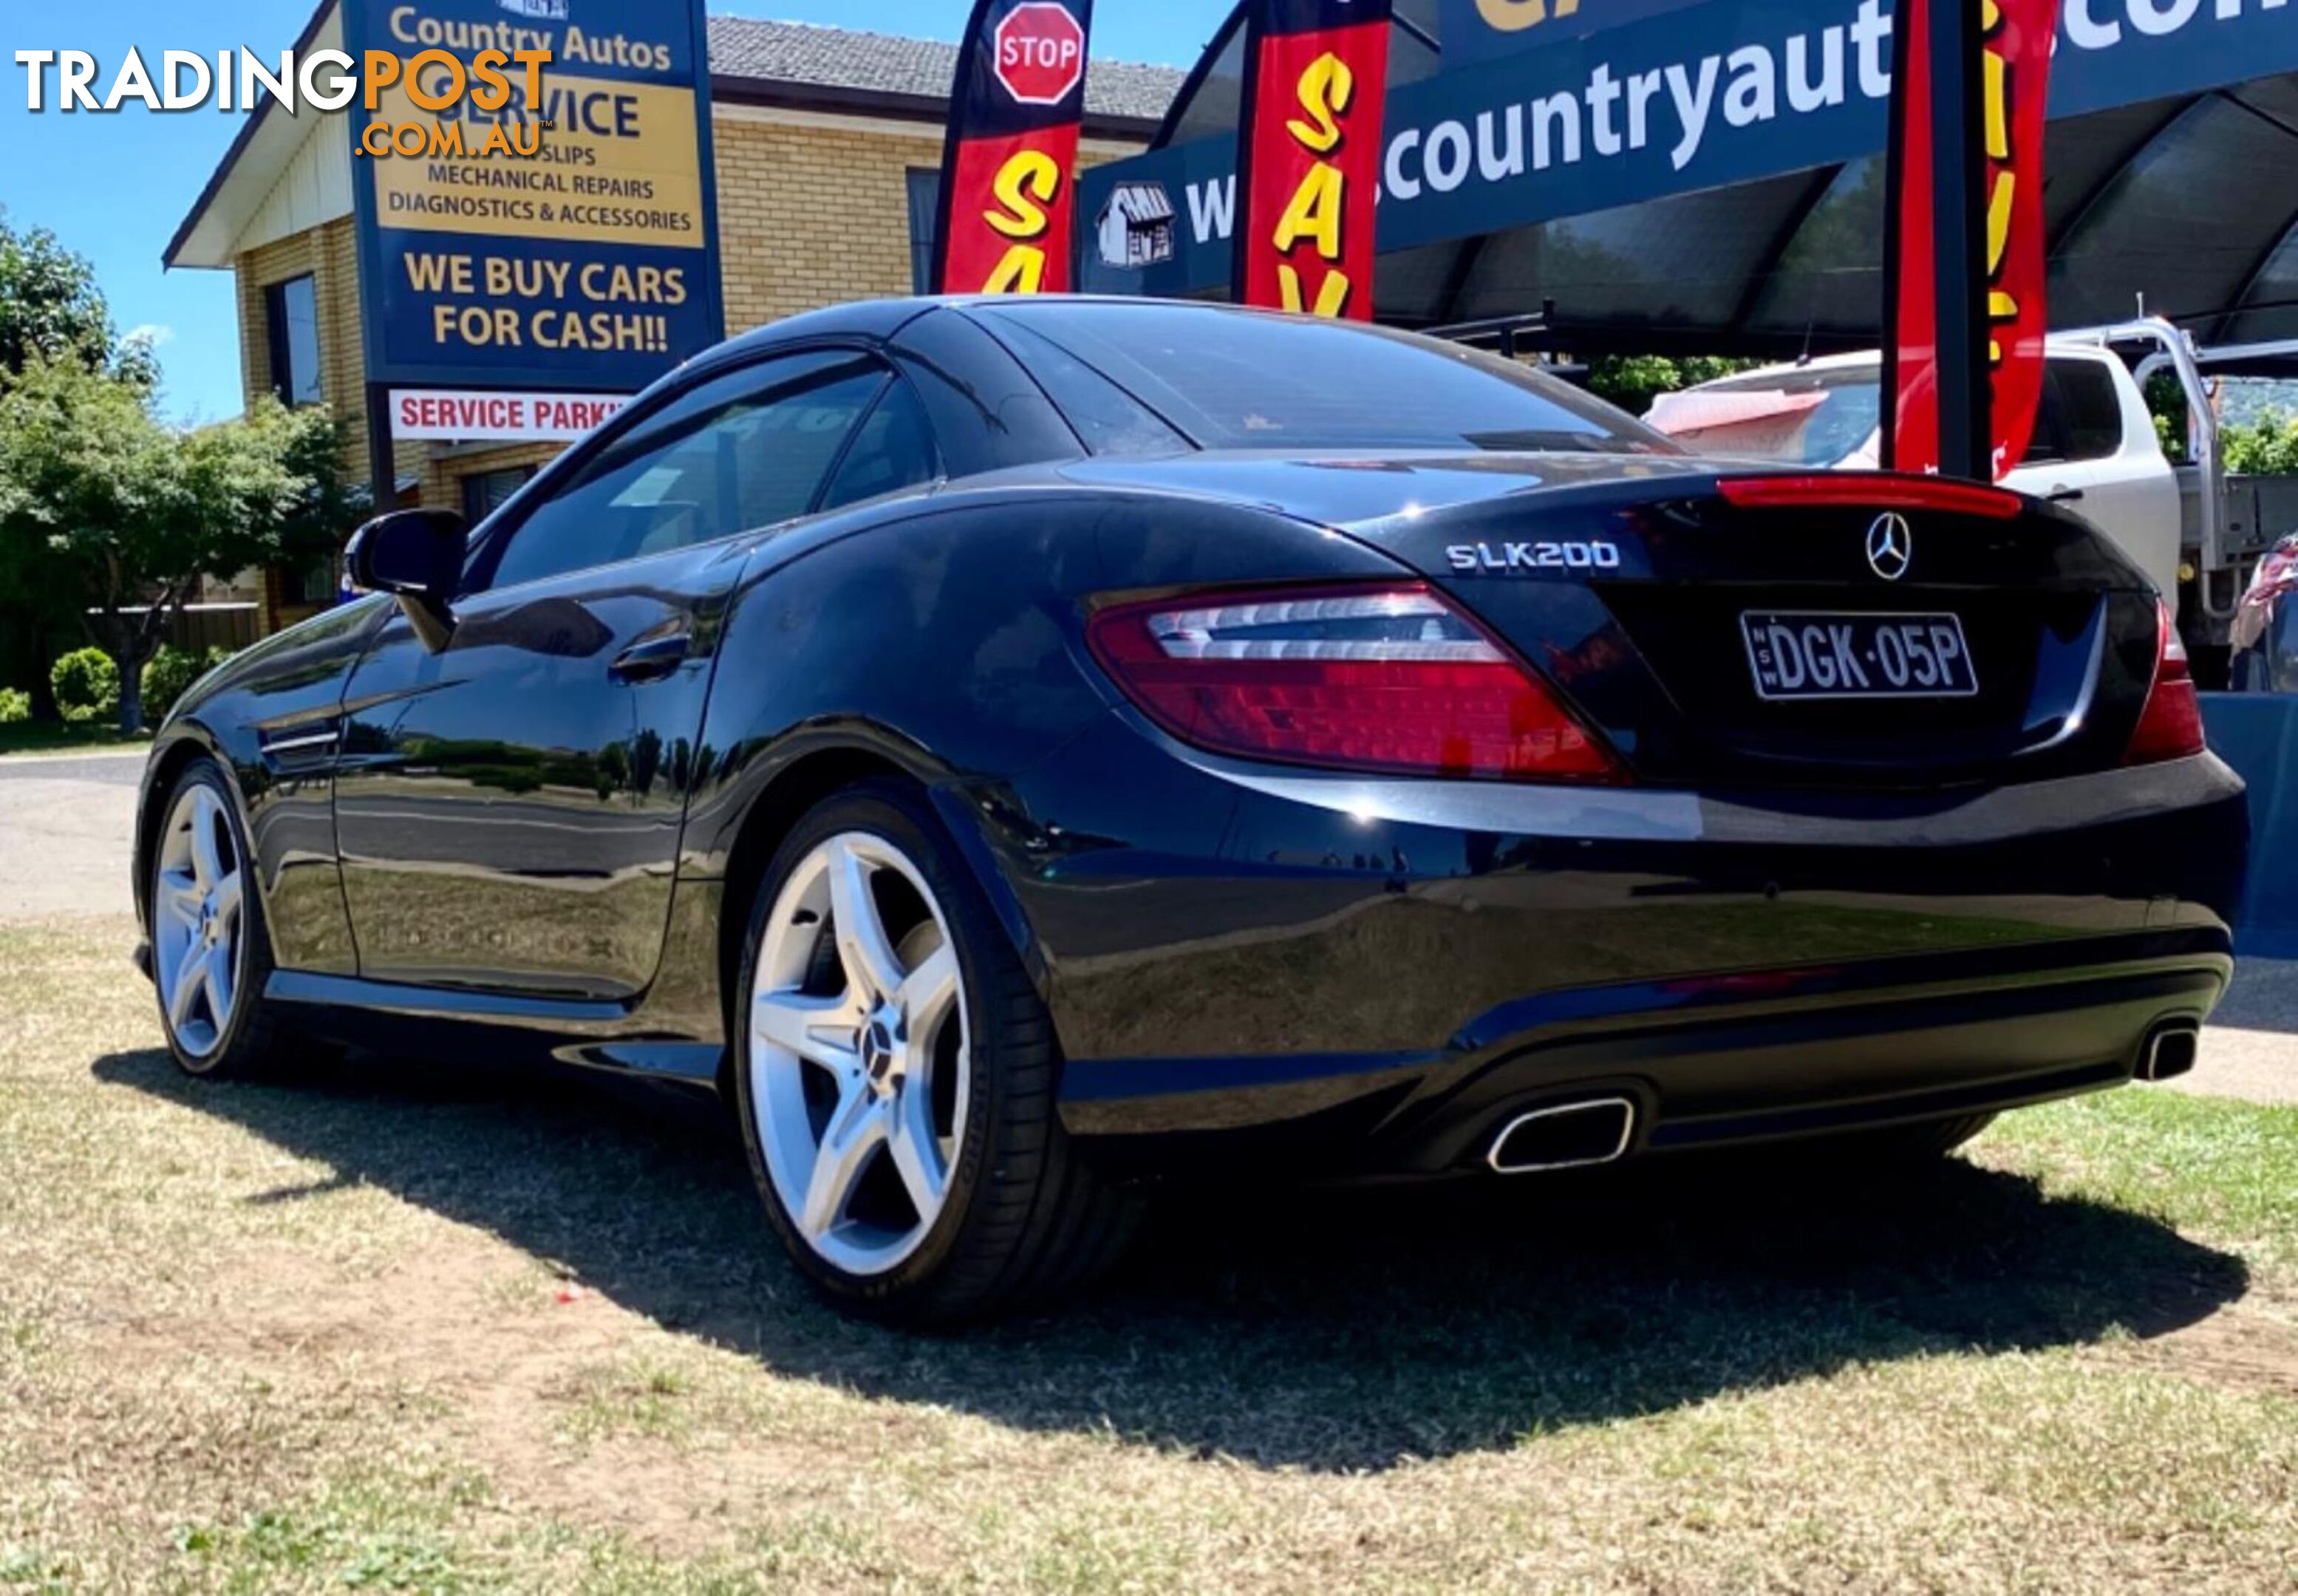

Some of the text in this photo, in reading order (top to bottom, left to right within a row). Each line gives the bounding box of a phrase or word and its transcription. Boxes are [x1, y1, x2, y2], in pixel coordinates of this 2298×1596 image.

[562, 27, 670, 70] Autos
[1002, 35, 1079, 68] STOP
[542, 145, 596, 166] SLIPS
[428, 165, 653, 200] MECHANICAL REPAIRS
[389, 192, 692, 231] DIAGNOSTICS & ACCESSORIES
[404, 253, 686, 304] WE BUY CARS
[433, 305, 669, 352] FOR CASH!!
[401, 397, 624, 429] SERVICE PARK
[1446, 541, 1620, 569] SLK200
